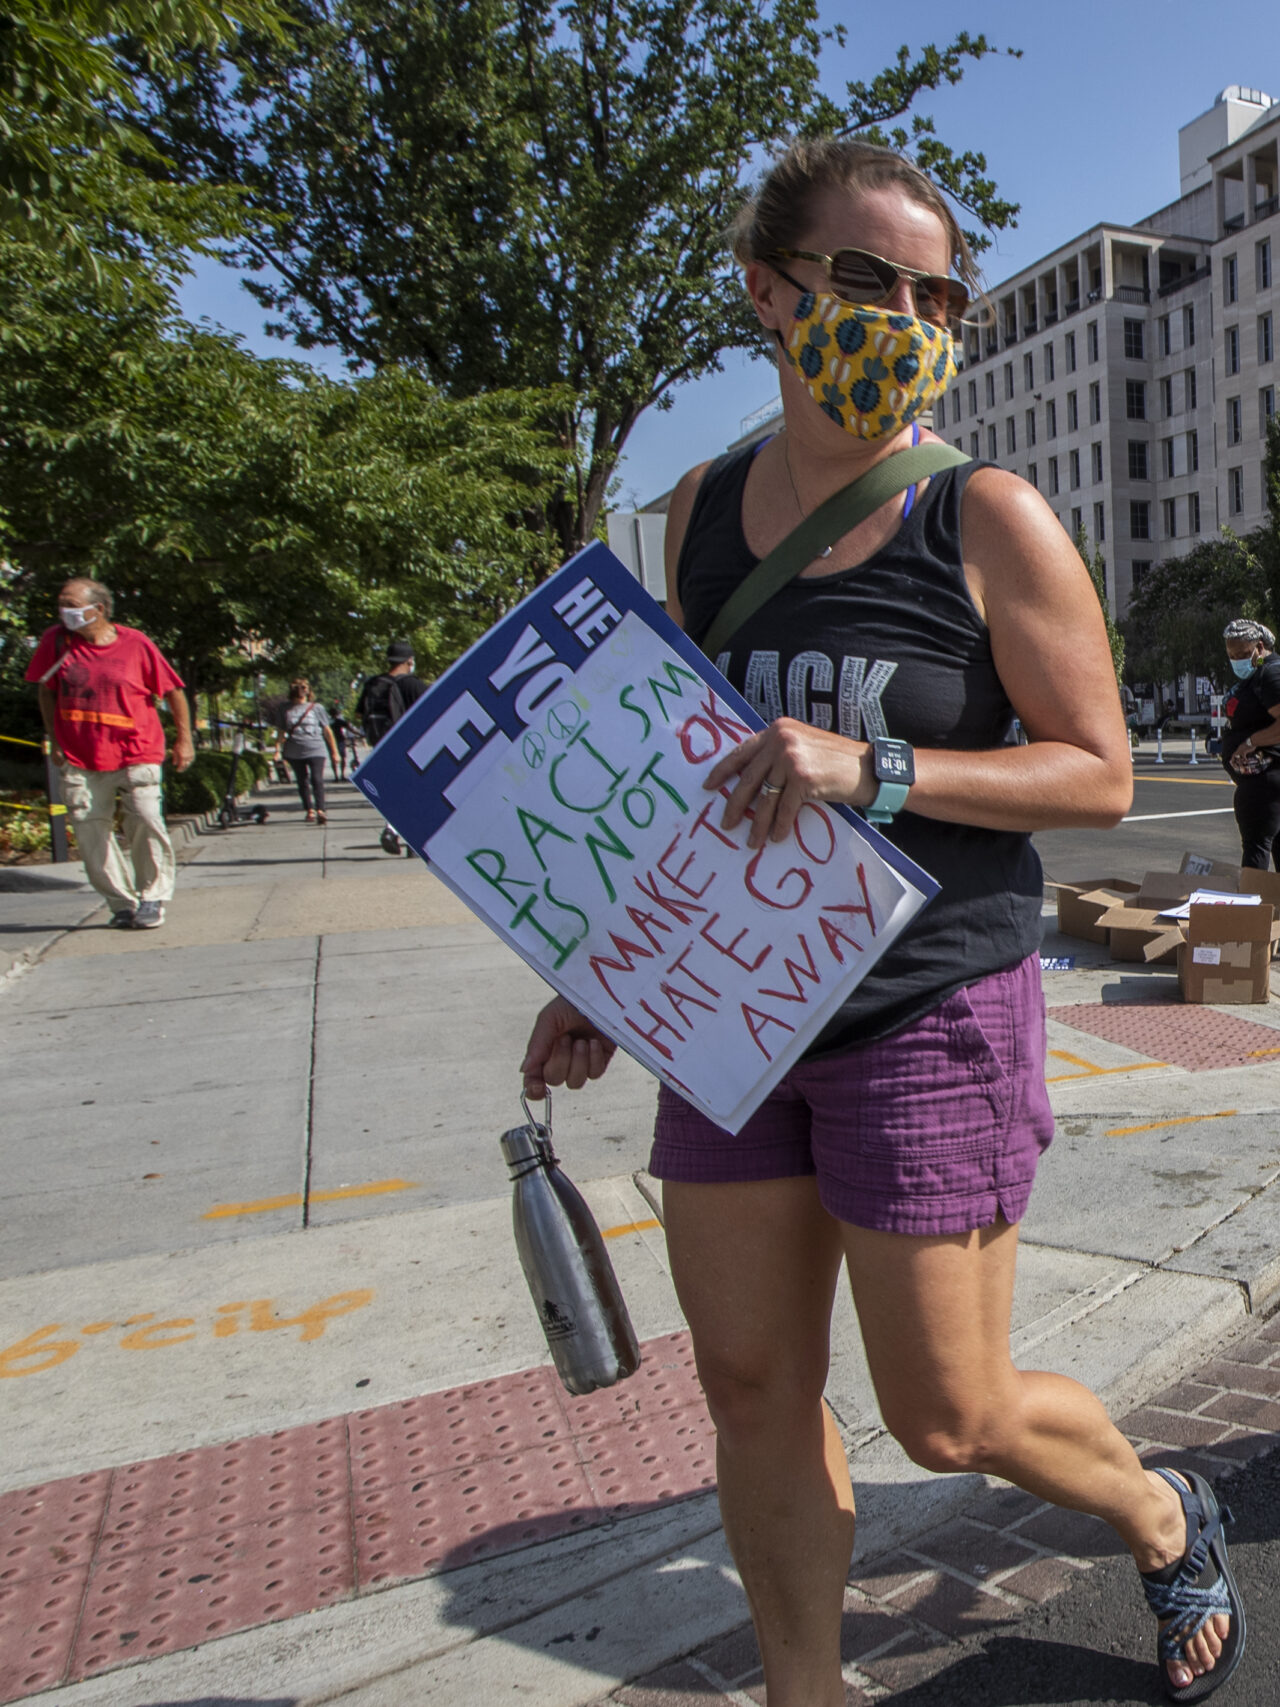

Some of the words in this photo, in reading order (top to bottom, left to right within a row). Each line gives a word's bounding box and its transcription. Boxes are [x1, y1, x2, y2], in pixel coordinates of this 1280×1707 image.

[465, 661, 704, 906] RACISM
[715, 650, 899, 742] ACK
[509, 877, 591, 971] IS
[584, 752, 690, 903] NOT
[679, 687, 753, 765] OK
[589, 832, 717, 1009] MAKE
[624, 912, 773, 1061] HATE
[744, 802, 836, 910] GO
[741, 862, 877, 1062] AWAY
